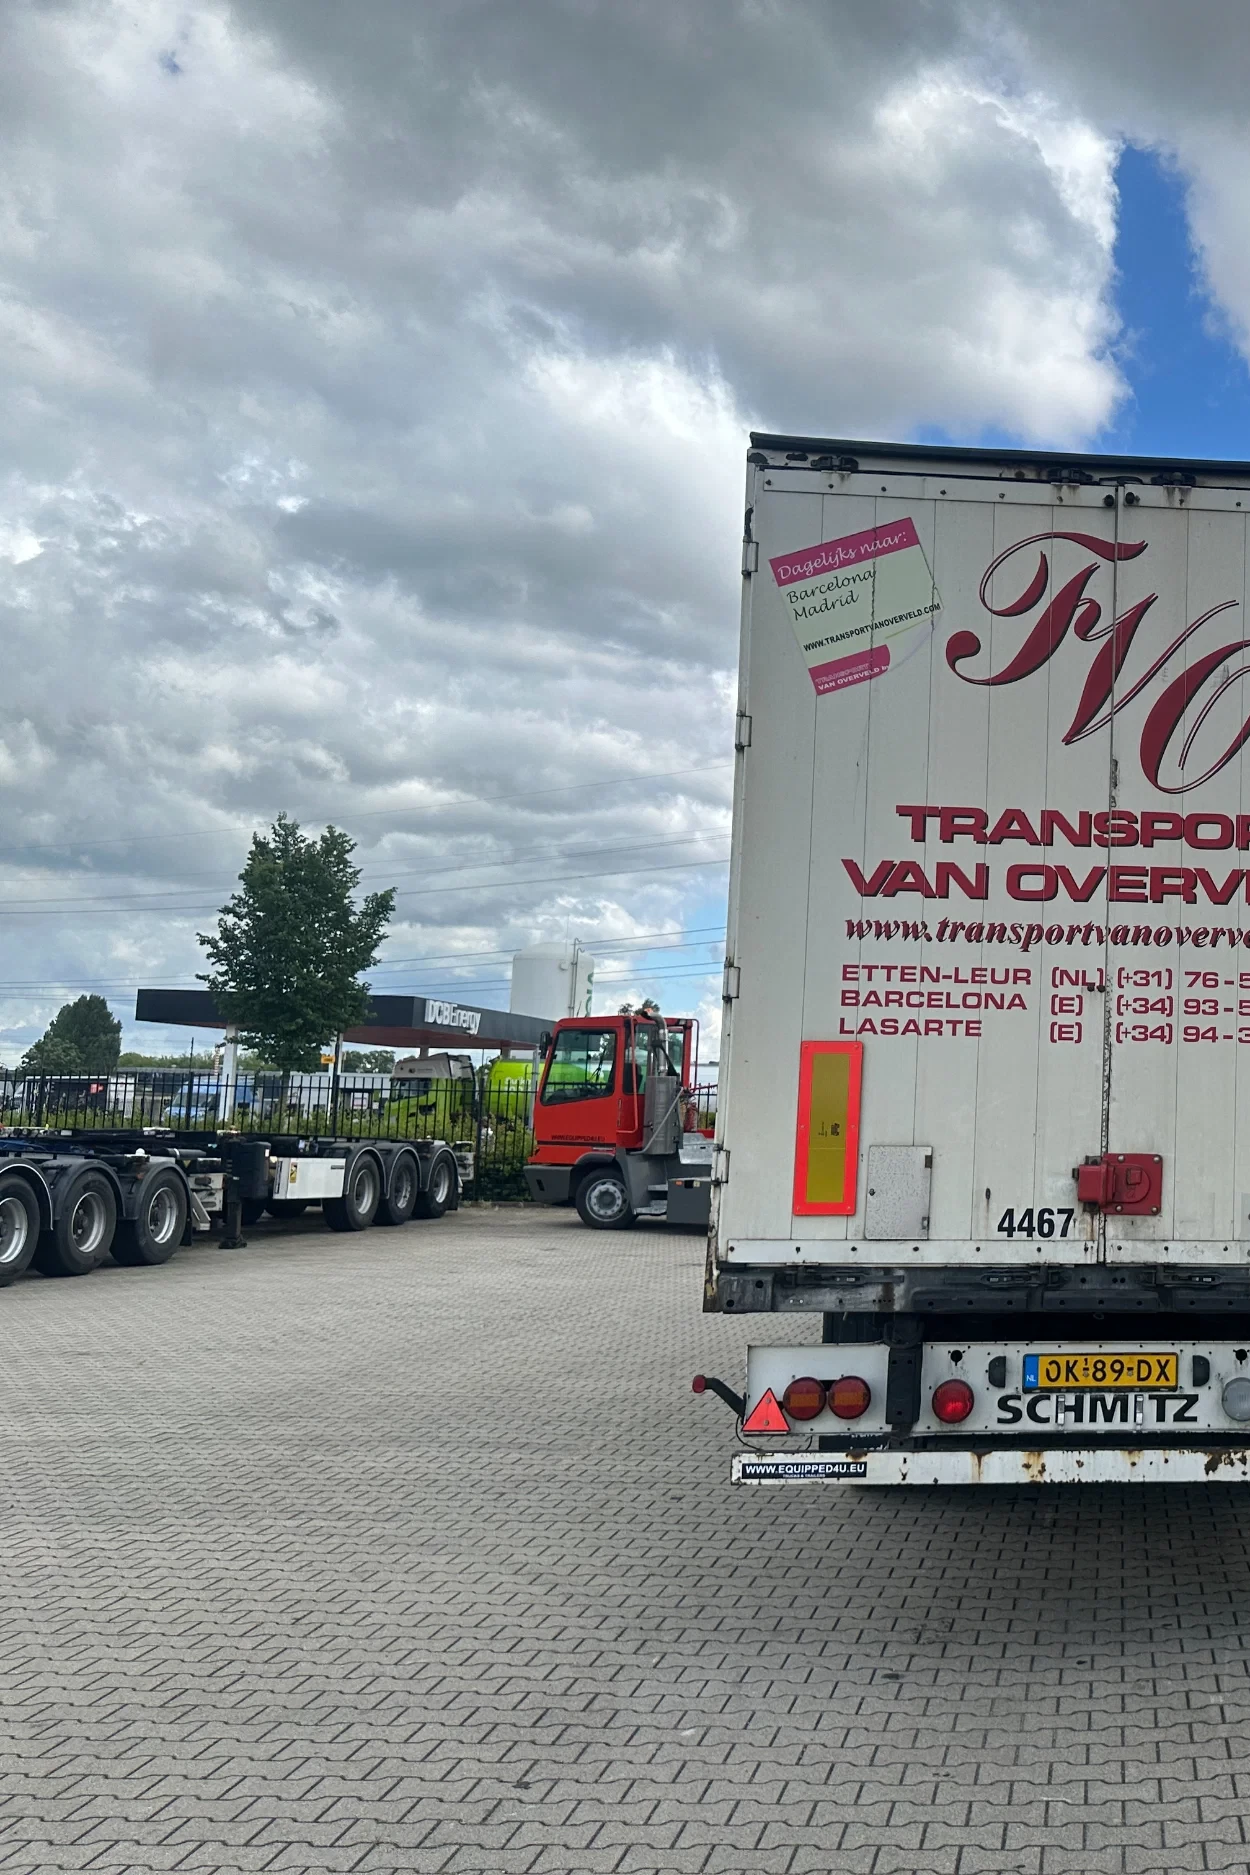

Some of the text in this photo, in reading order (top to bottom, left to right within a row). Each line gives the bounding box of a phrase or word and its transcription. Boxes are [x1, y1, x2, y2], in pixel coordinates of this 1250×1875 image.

[777, 531, 907, 581] Dagelijks naar:
[786, 569, 876, 604] Barcelona
[793, 590, 860, 621] Madrid
[803, 603, 941, 652] WWW.TRANSPORTVANOVERVELD.COM
[817, 681, 836, 690] VAN
[837, 667, 880, 685] OVERVELD
[841, 858, 990, 900] VAN
[842, 964, 1032, 985] ETTEN-LEUR
[1117, 966, 1173, 989] (+31)
[840, 989, 1027, 1010] BARCELONA
[1050, 994, 1083, 1016] (E)
[1116, 994, 1174, 1017] (+34)
[839, 1017, 982, 1037] LASARTE
[1050, 1021, 1083, 1044] (E)
[1115, 1022, 1173, 1044] (+34)
[997, 1208, 1075, 1238] 4467
[1026, 1374, 1036, 1382] NL
[745, 1463, 865, 1474] WWW.EQUIPPED4U.EU
